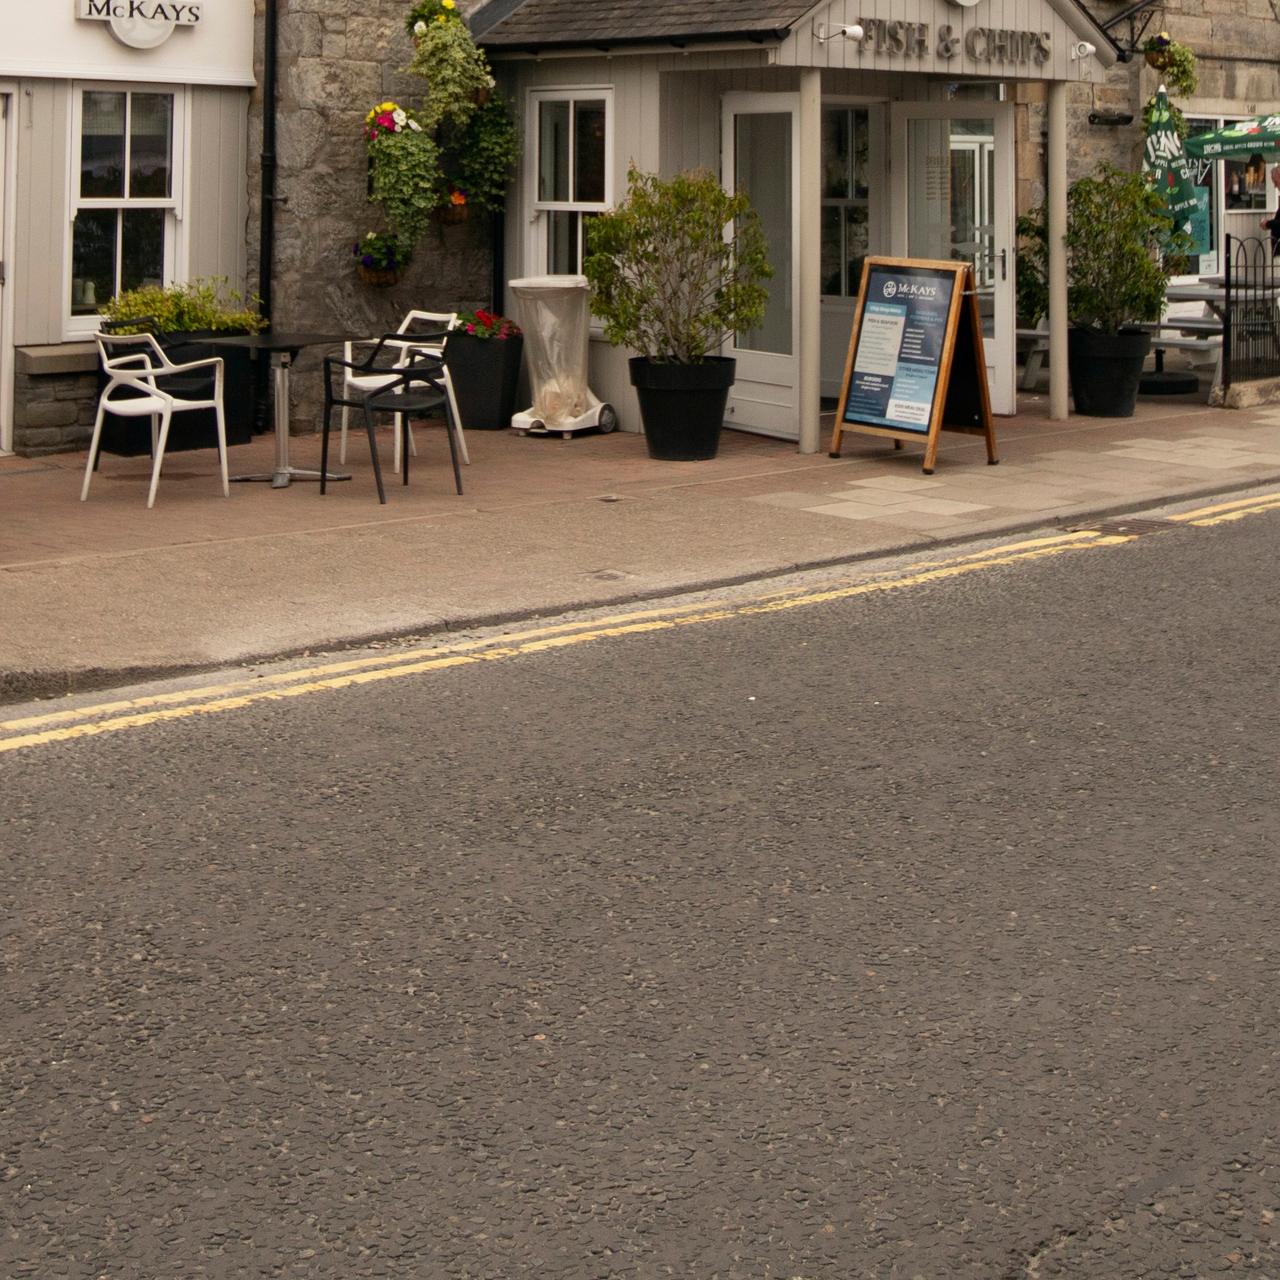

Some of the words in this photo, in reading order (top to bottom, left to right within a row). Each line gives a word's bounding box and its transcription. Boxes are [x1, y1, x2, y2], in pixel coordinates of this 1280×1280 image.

[858, 17, 930, 58] FISH
[936, 24, 961, 61] &
[965, 27, 1051, 66] CHIPS
[898, 283, 937, 296] McKAYS
